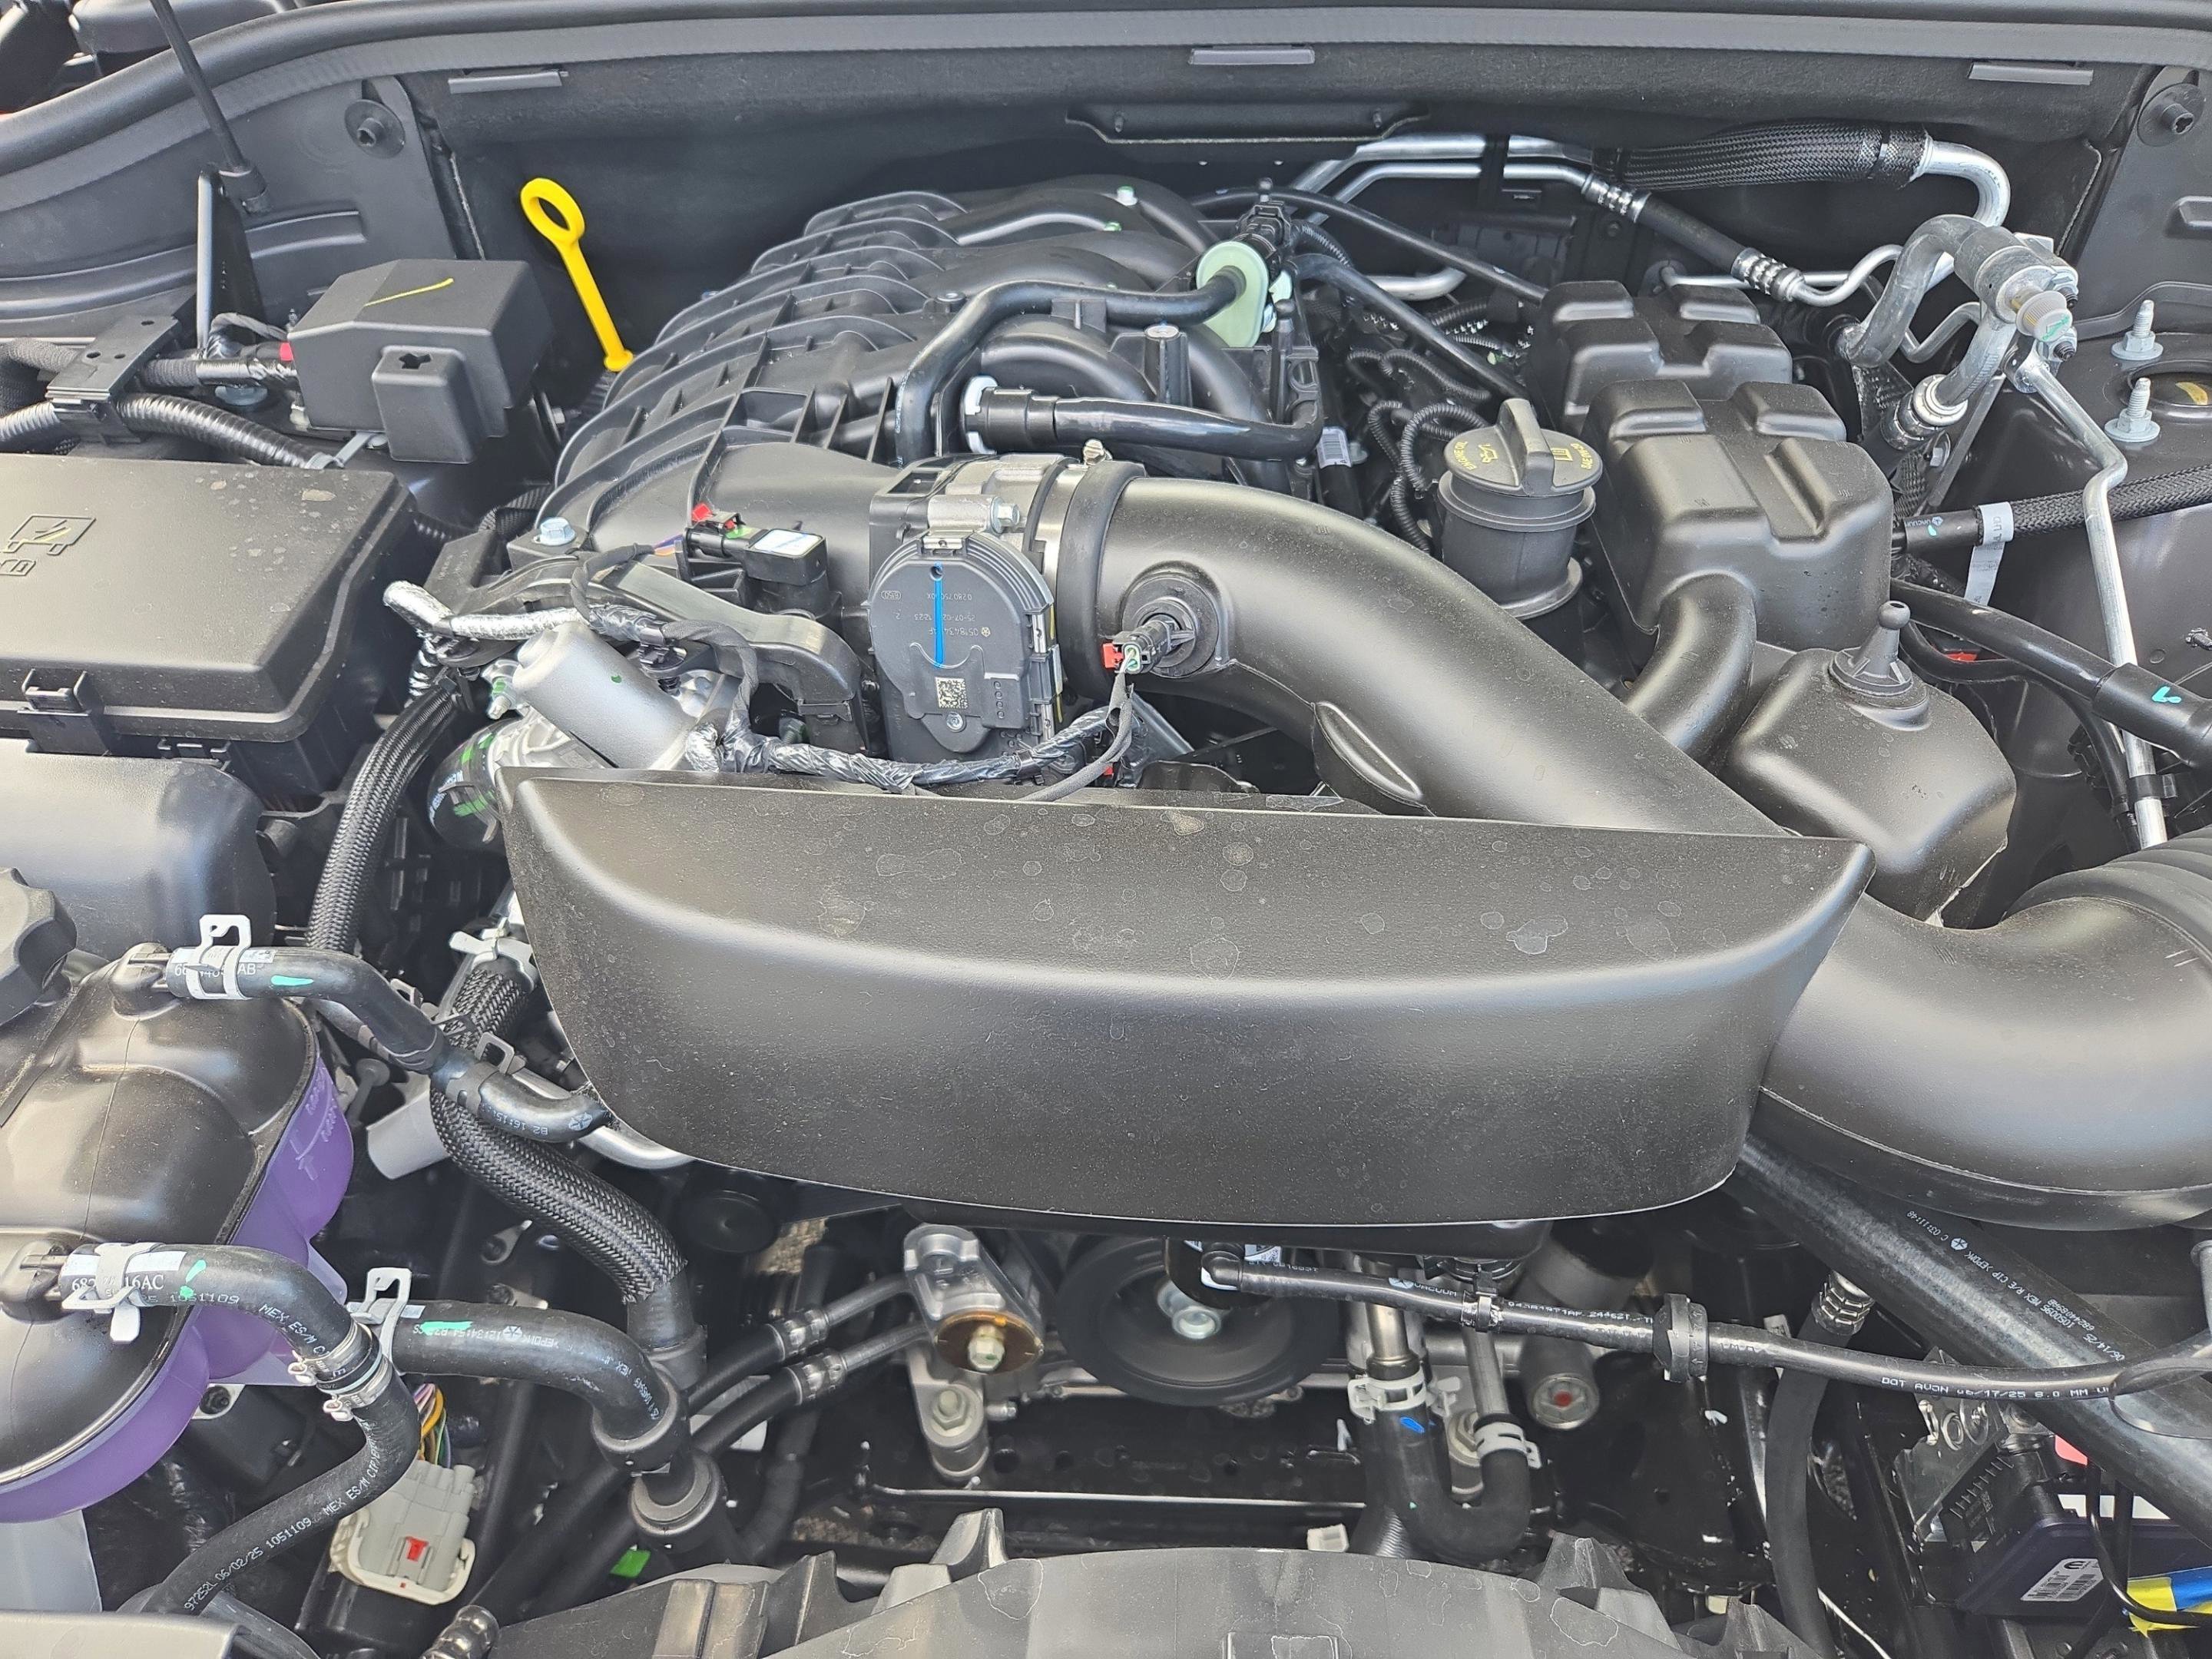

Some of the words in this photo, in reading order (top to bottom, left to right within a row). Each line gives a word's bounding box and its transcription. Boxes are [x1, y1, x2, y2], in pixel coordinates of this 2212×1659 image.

[2023, 1292, 2041, 1306] MEX
[259, 1303, 290, 1324] MEX
[1882, 1376, 1906, 1388] DOT
[2035, 1389, 2060, 1399] 8.0
[2069, 1387, 2088, 1397] MM
[215, 1547, 263, 1581] 06/02/25
[266, 1517, 312, 1549] 1051109
[323, 1498, 347, 1516] MEX
